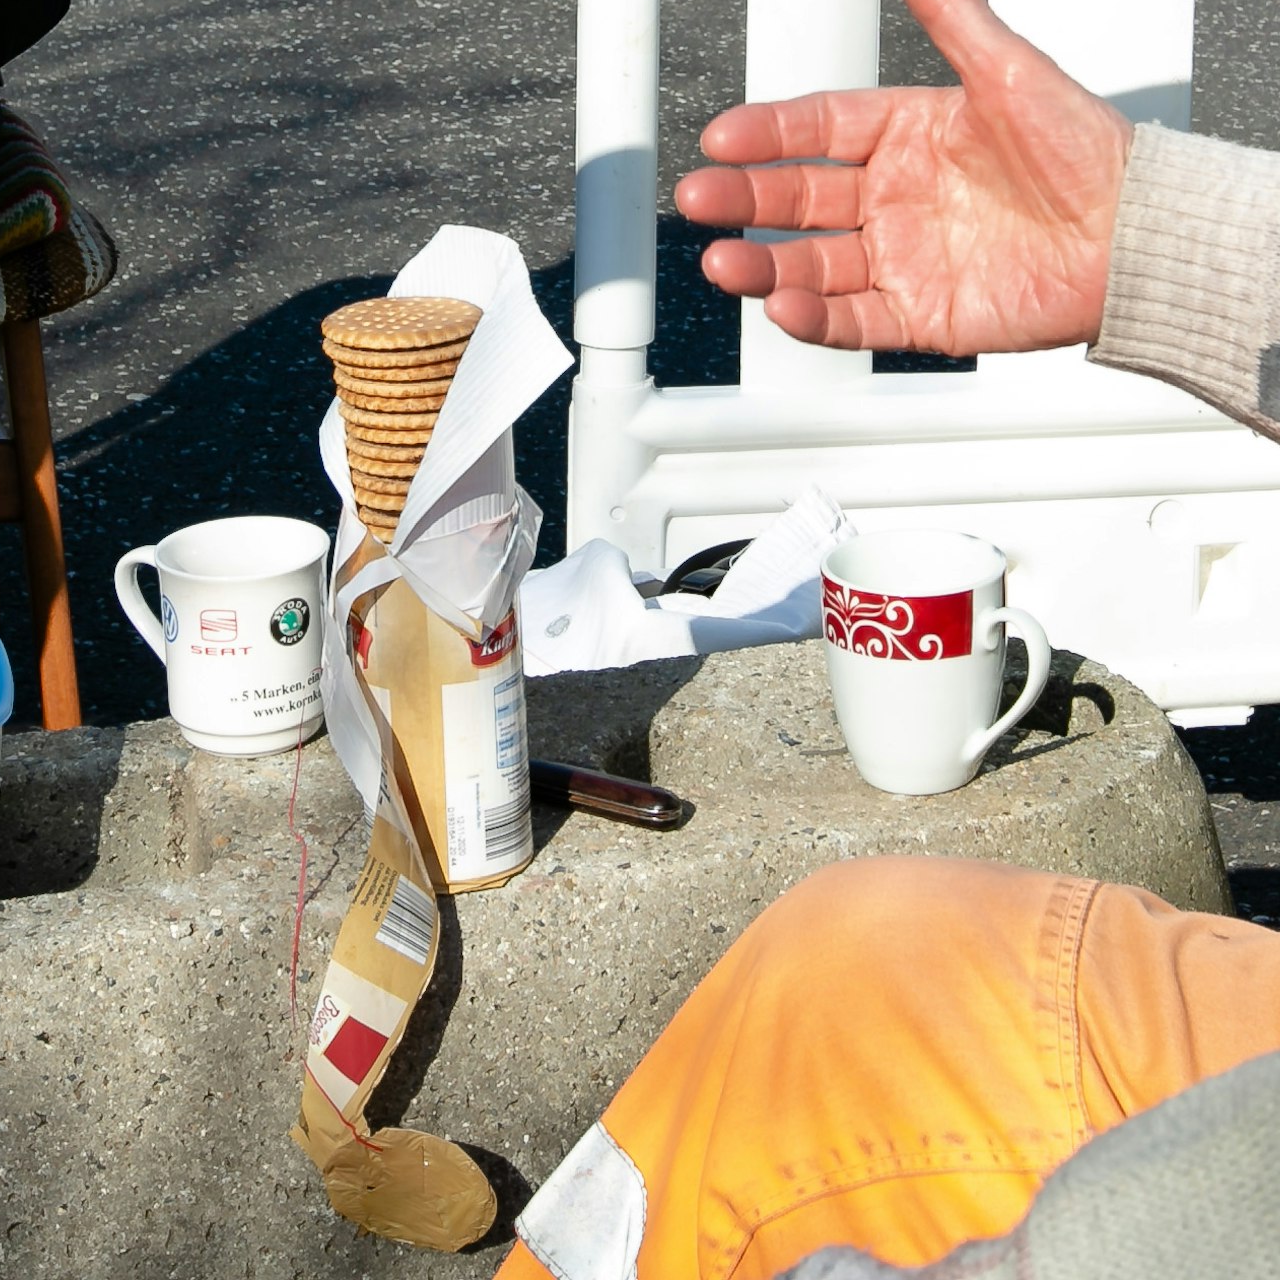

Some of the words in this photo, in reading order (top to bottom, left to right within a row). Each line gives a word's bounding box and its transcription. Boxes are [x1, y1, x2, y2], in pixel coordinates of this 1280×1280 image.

[280, 630, 303, 643] AUTO
[191, 645, 252, 656] SEAT
[253, 680, 306, 700] Marken,
